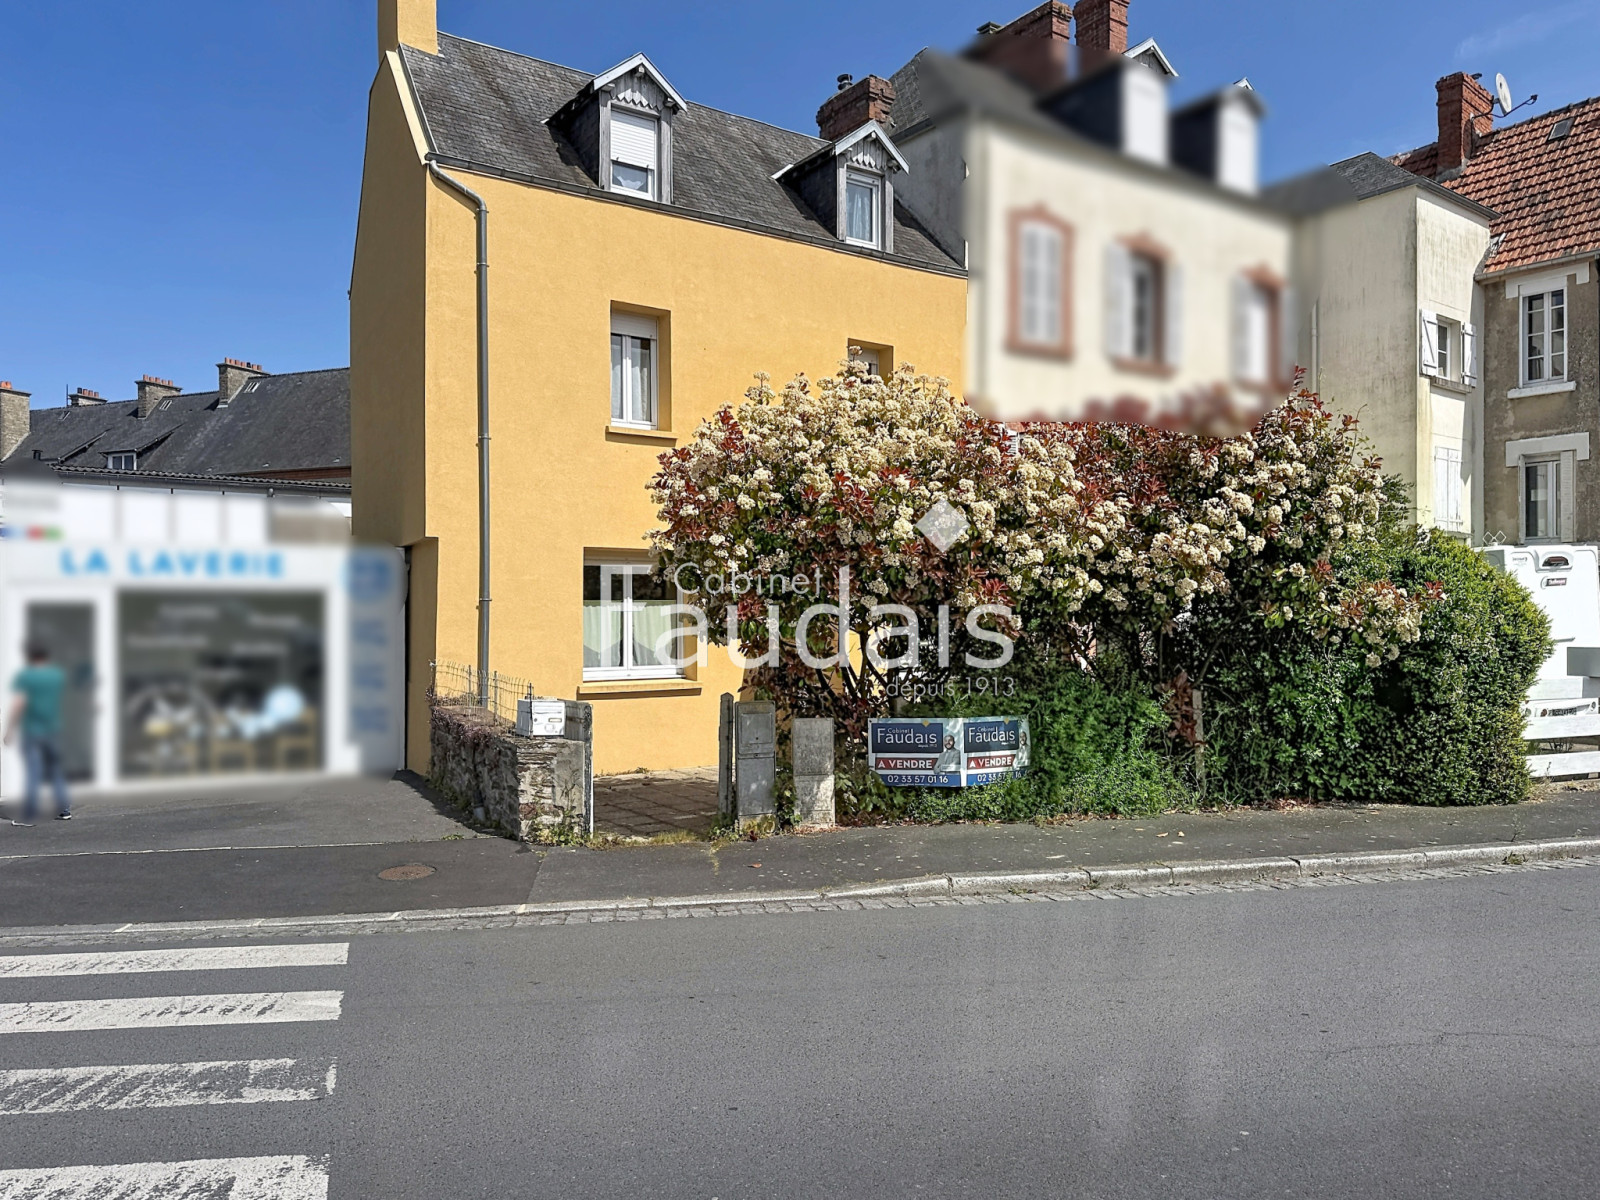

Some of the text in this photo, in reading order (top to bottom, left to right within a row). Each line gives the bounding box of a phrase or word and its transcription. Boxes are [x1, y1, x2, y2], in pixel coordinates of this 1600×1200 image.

[60, 549, 284, 577] LA LAVERIE
[877, 728, 937, 744] Faudais
[968, 726, 1015, 743] Faudais
[878, 760, 933, 769] A VENDRE
[969, 756, 1012, 768] A VENDRE
[887, 775, 949, 783] 02 33 57 01 16
[977, 774, 987, 782] 02
